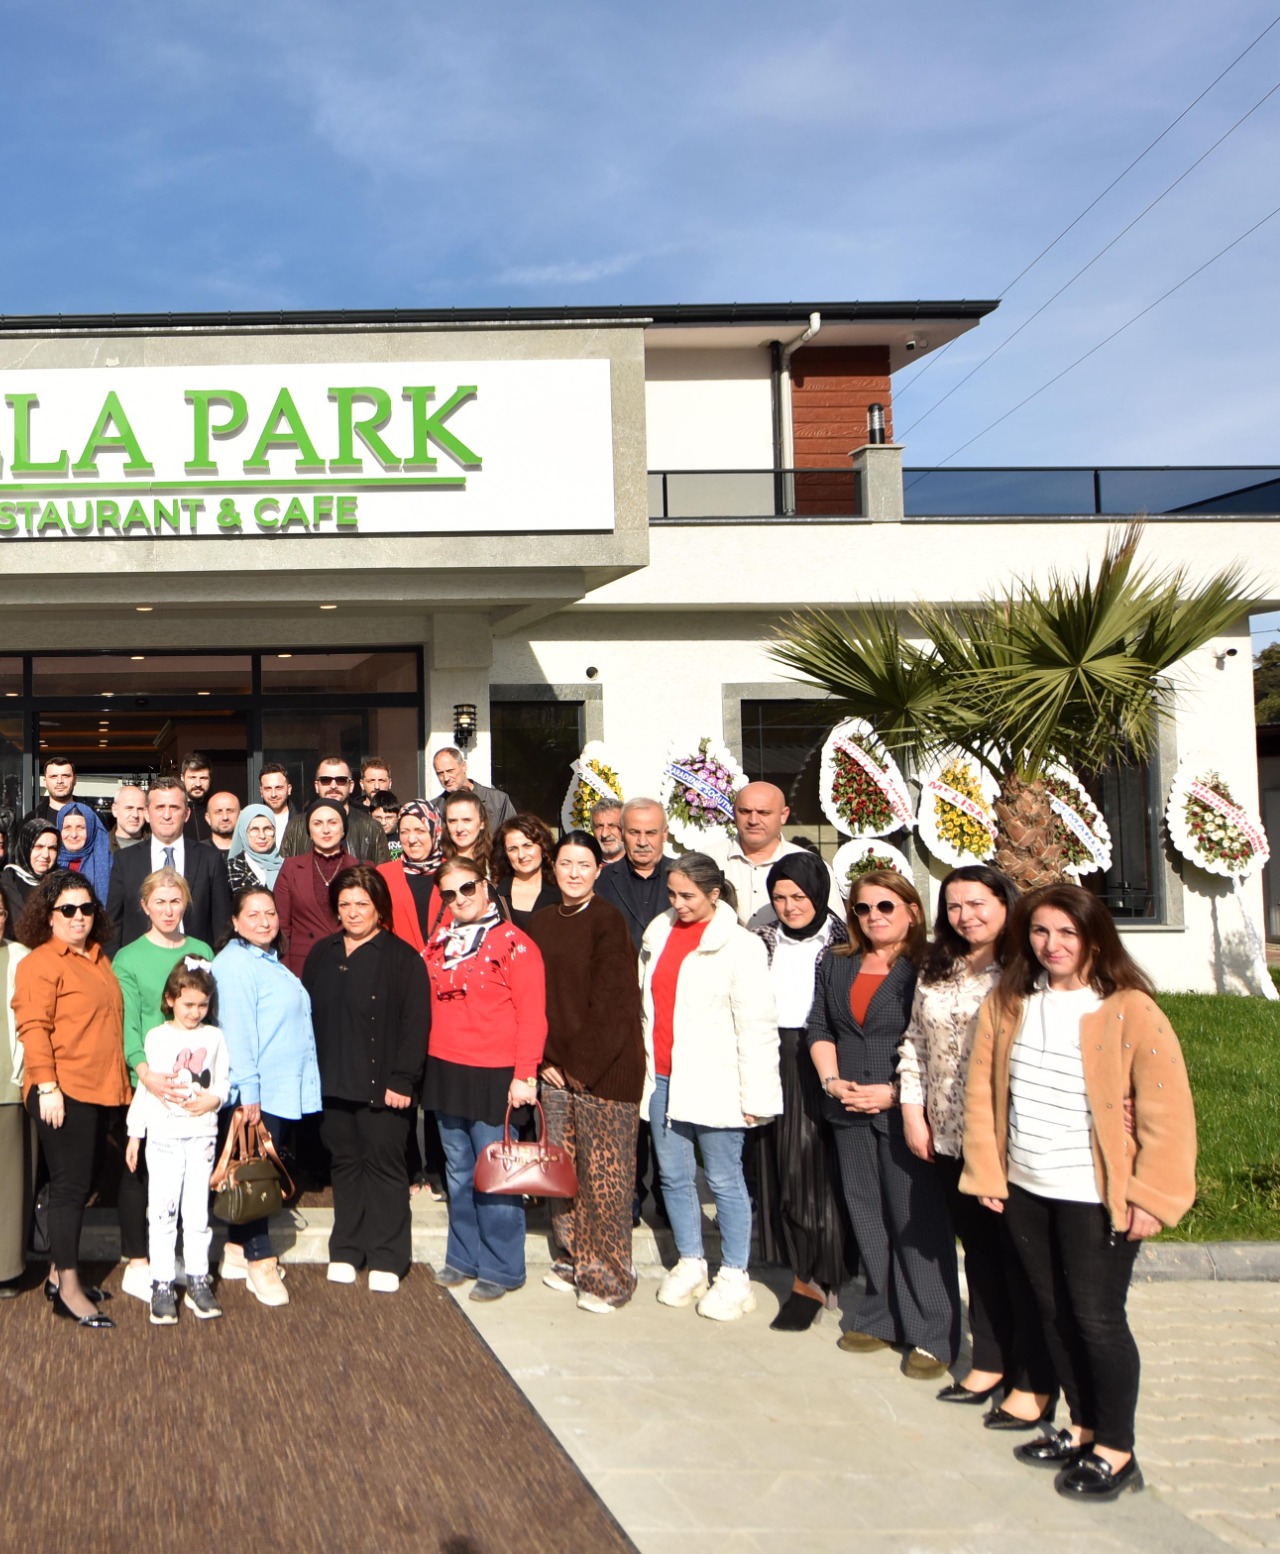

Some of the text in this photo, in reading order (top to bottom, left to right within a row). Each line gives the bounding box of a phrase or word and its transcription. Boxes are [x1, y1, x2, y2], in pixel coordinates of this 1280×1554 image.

[184, 385, 482, 468] PARK
[216, 498, 242, 528] &
[254, 496, 358, 528] CAFE
